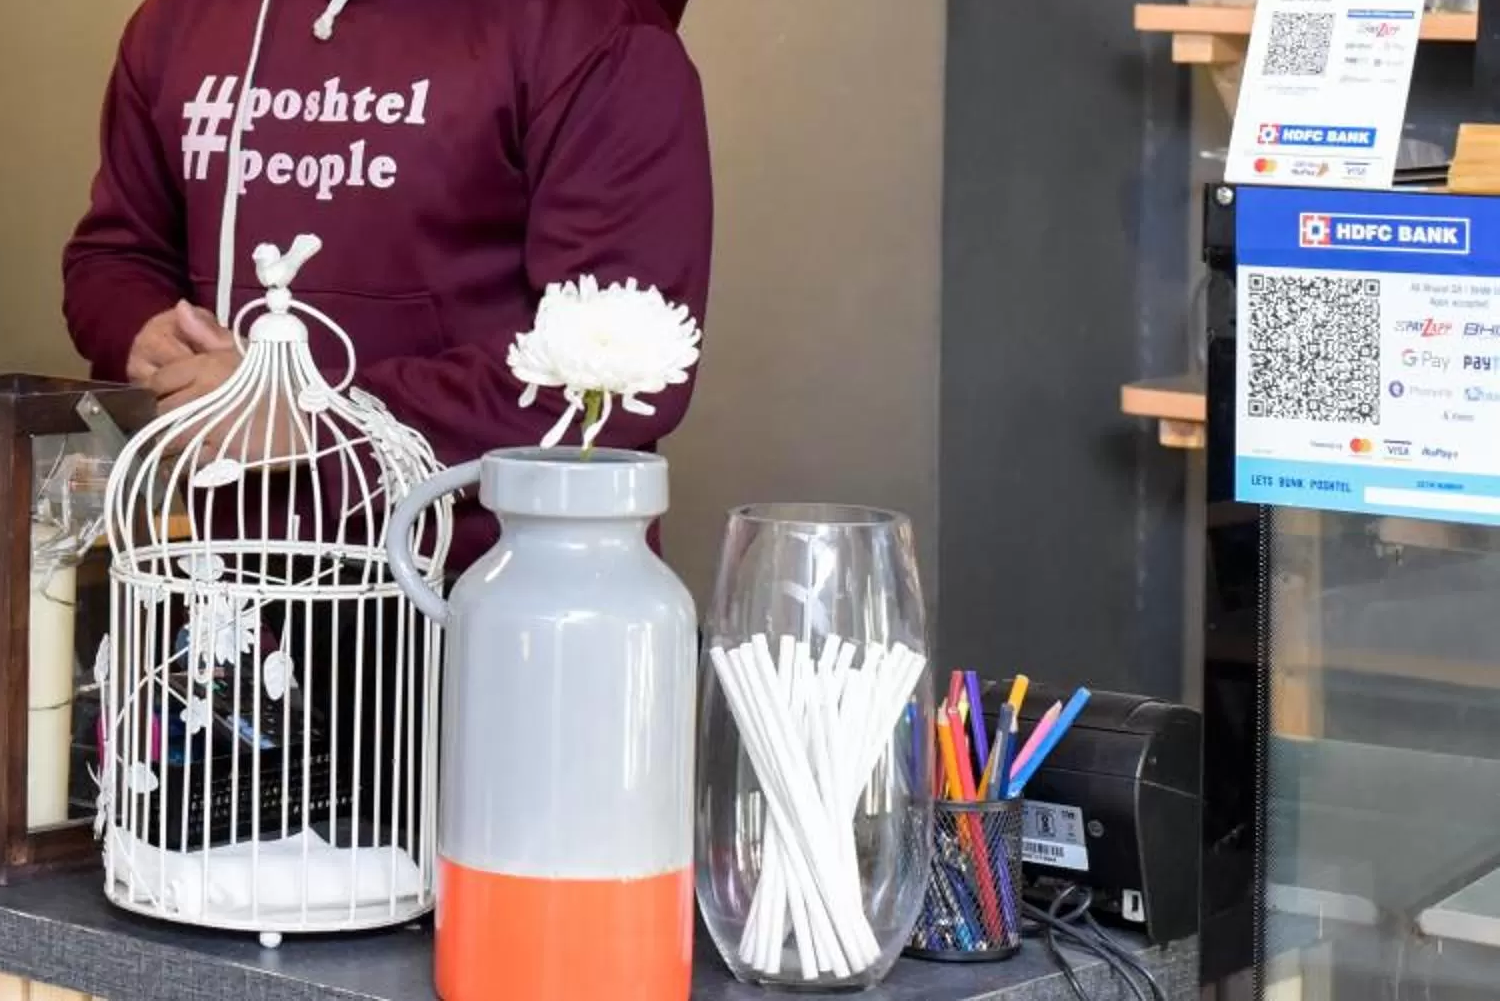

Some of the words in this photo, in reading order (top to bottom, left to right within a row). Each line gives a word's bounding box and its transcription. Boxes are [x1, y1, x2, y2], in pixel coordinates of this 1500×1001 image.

[242, 75, 430, 130] poshtel
[1282, 128, 1324, 141] HDFC
[1326, 130, 1371, 144] BANK
[236, 139, 397, 200] people
[1335, 223, 1393, 242] HDFC
[1398, 225, 1458, 245] BANK
